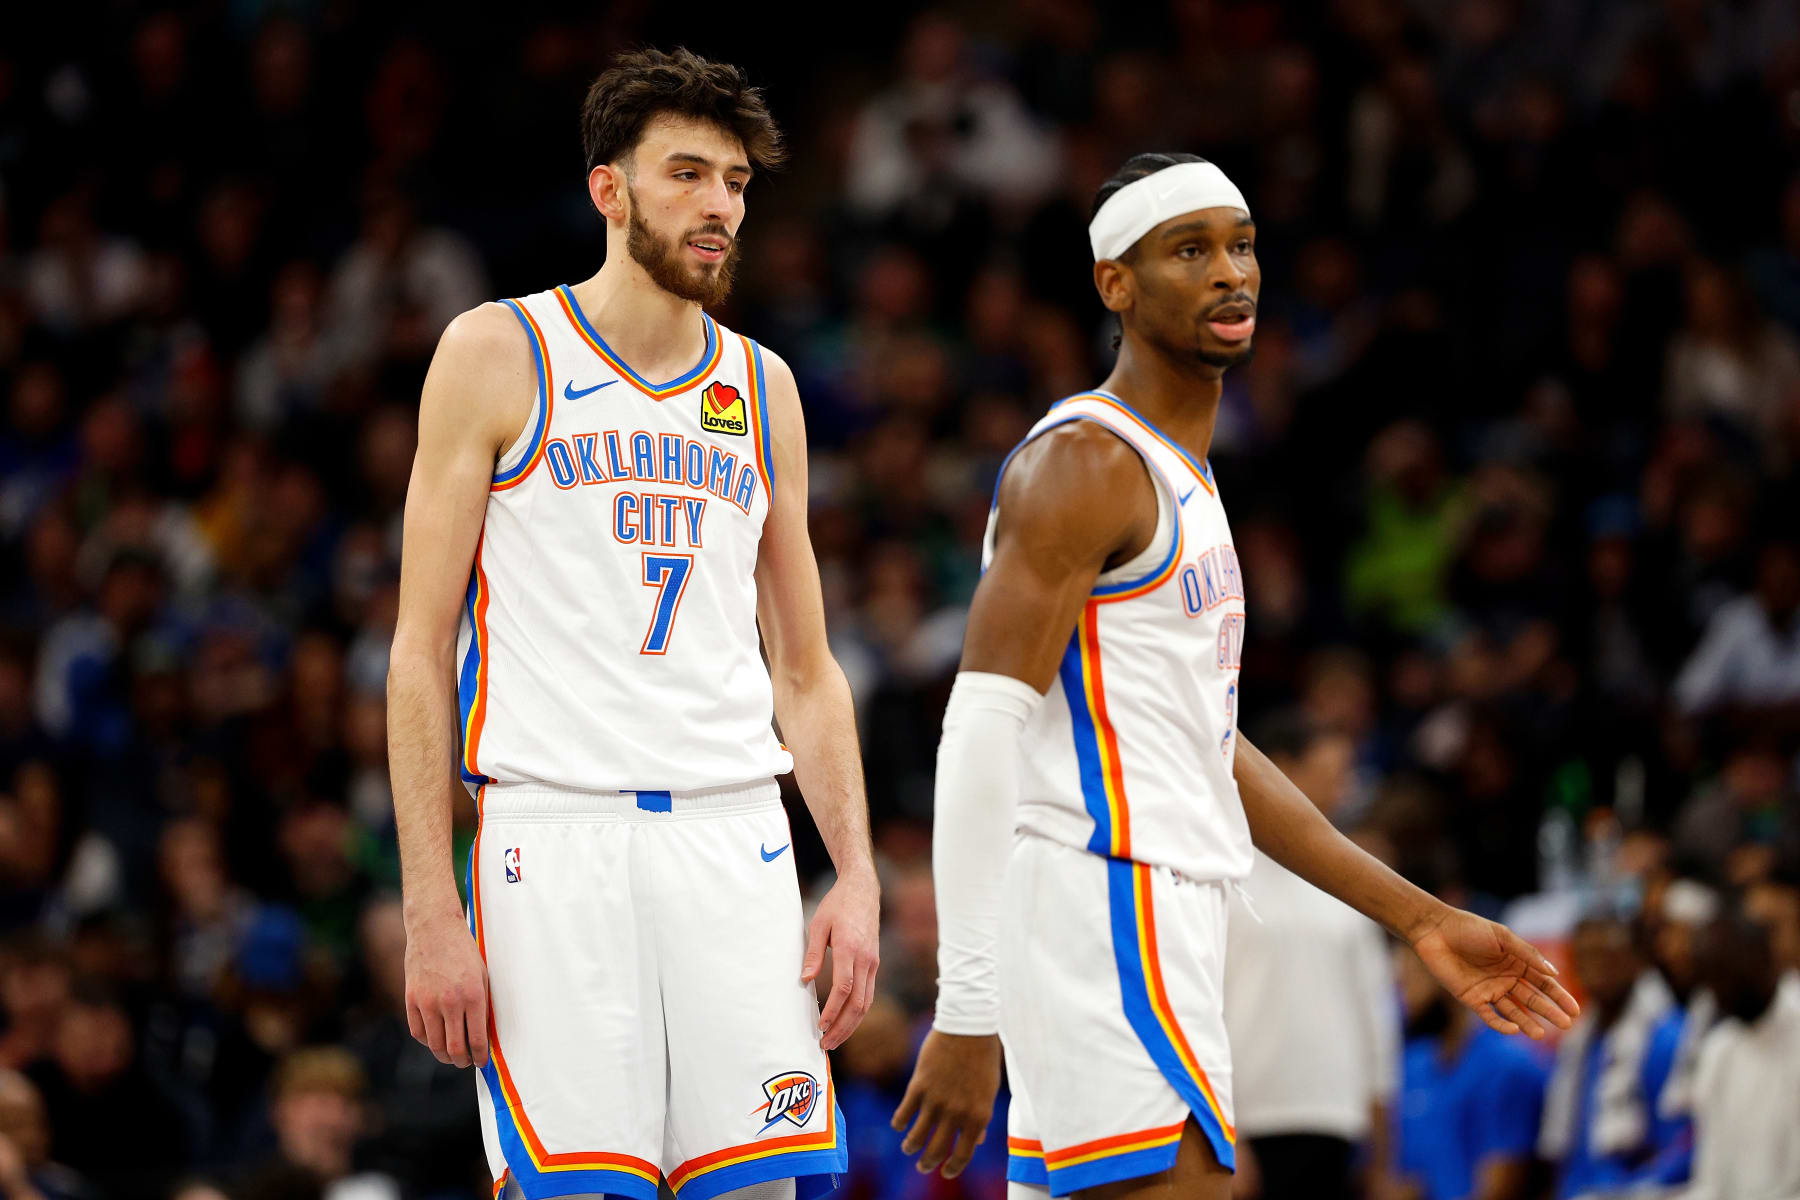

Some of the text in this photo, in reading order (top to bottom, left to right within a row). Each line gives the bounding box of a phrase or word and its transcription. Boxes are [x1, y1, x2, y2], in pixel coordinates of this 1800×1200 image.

[544, 430, 757, 516] OKLAHOMA
[613, 491, 707, 548] CITY
[640, 552, 694, 655] 7
[766, 1080, 811, 1121] OKC
